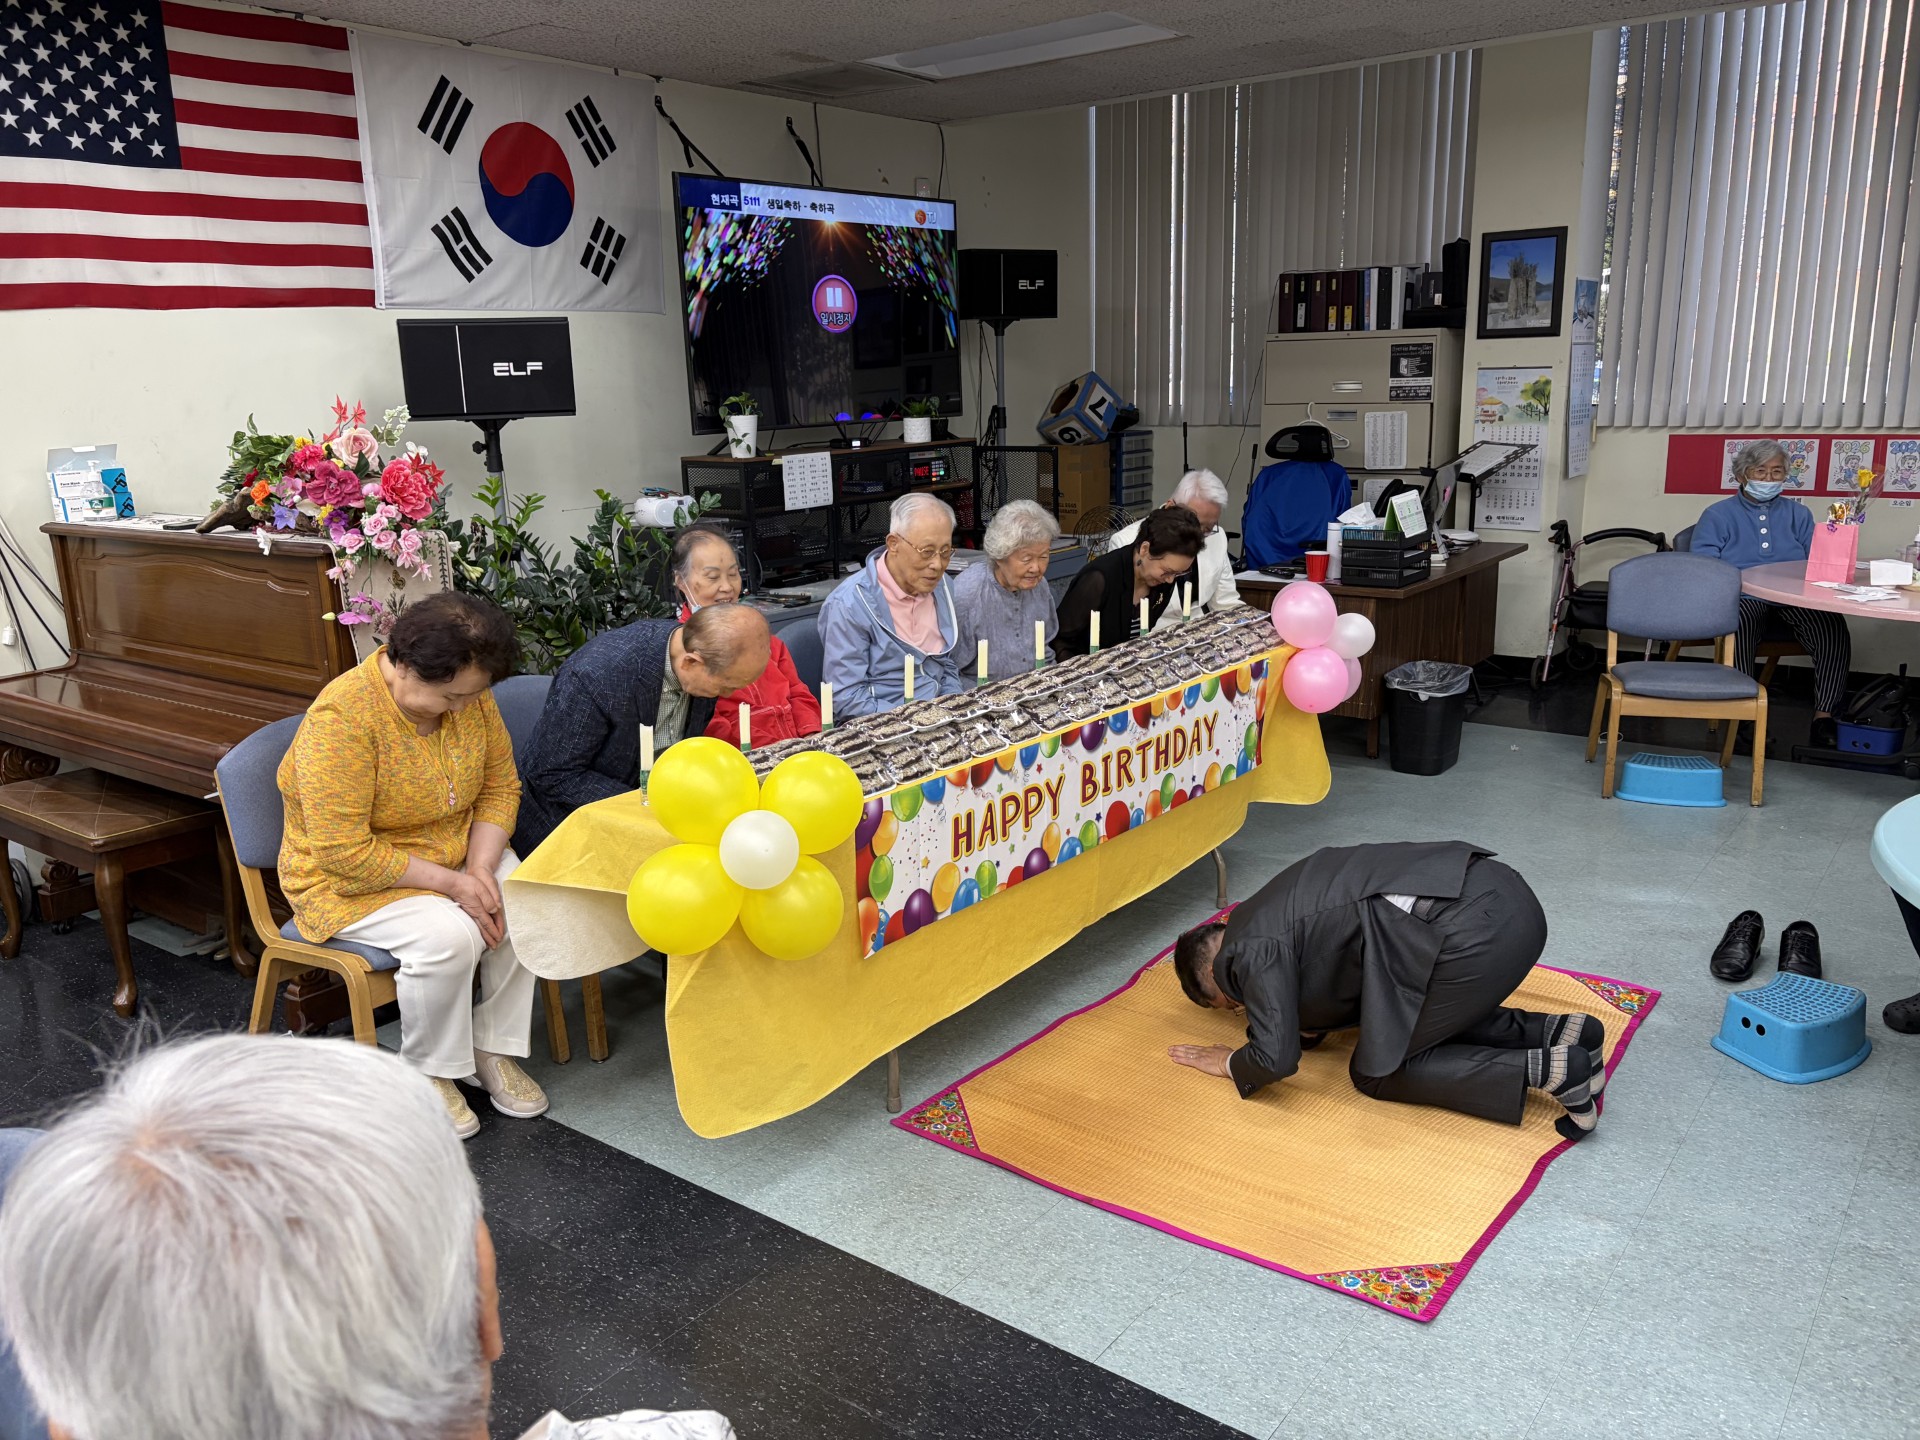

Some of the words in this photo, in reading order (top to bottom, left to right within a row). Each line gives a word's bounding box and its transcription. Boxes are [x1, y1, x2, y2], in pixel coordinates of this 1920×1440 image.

[710, 192, 739, 207] 현재곡
[743, 195, 761, 207] 5111
[766, 198, 802, 213] 생일축하
[809, 202, 835, 215] 축하곡
[1018, 279, 1045, 290] ELF
[820, 312, 852, 325] 일시정지
[493, 361, 543, 377] ELF
[1834, 440, 1871, 455] 2026
[951, 772, 1065, 861] HAPPY
[1080, 710, 1219, 807] BIRTHDAY
